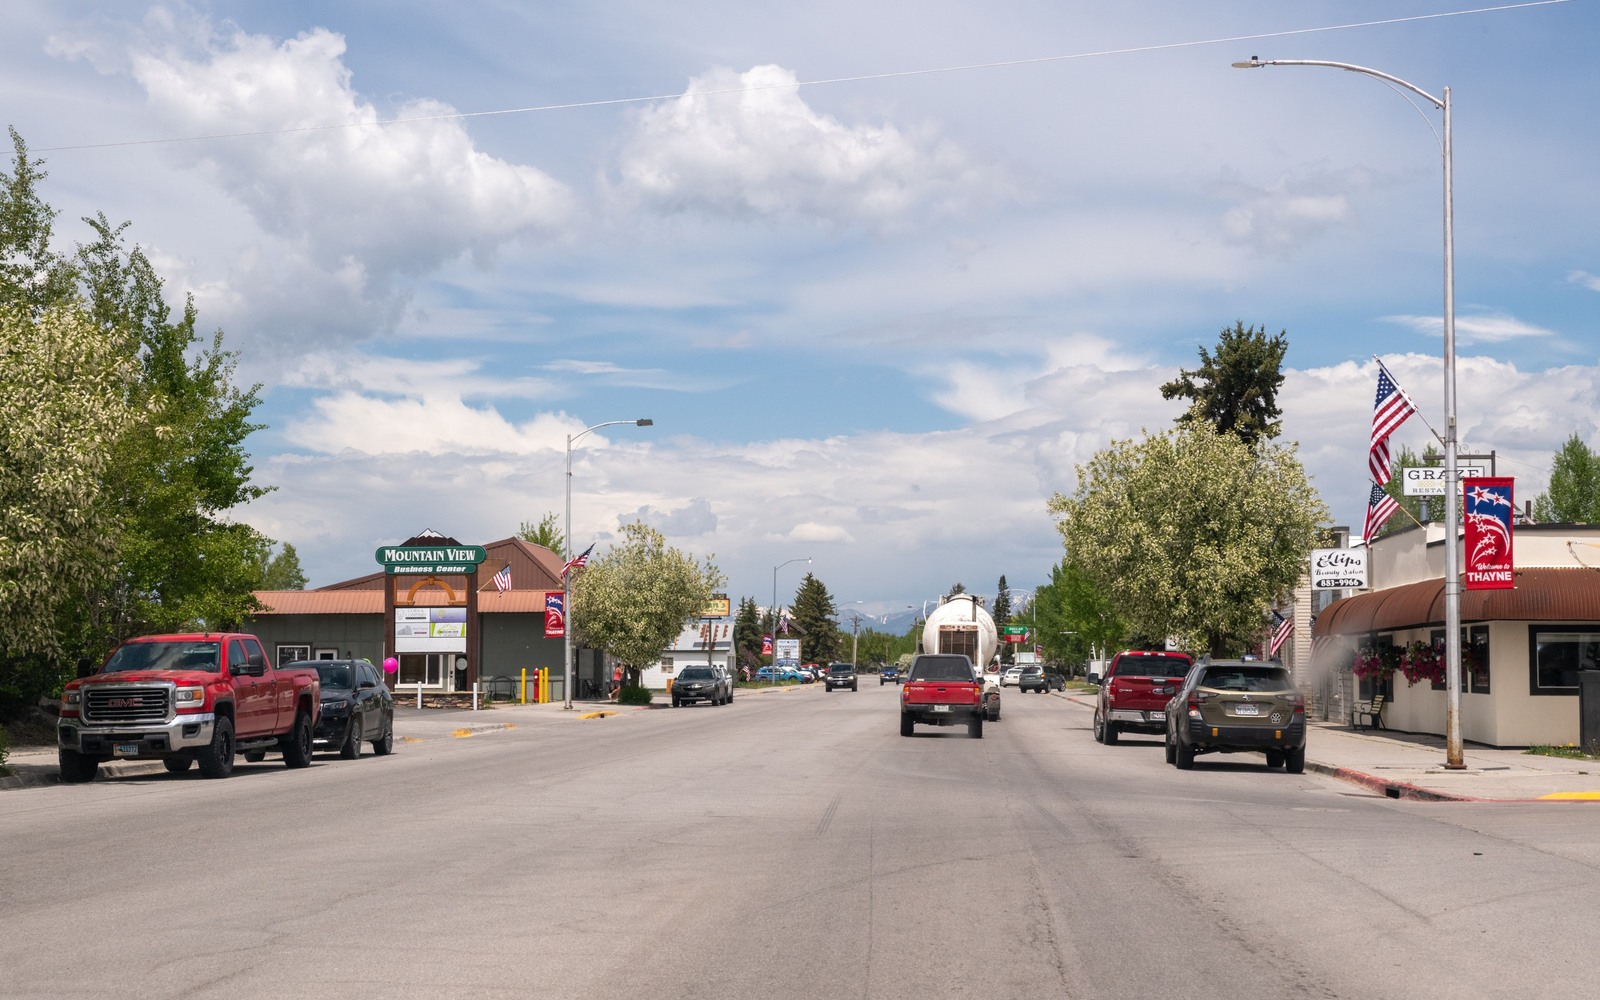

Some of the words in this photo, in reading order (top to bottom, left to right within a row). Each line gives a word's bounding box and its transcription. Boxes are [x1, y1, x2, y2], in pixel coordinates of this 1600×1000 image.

[384, 549, 444, 562] MOUNTAIN
[446, 548, 476, 561] VIEW
[436, 565, 467, 573] Center
[1475, 562, 1503, 571] Welcome
[1315, 569, 1340, 578] Beauty
[1467, 571, 1512, 582] THAYNE
[1320, 579, 1359, 587] 883-9966
[108, 698, 143, 707] GMC
